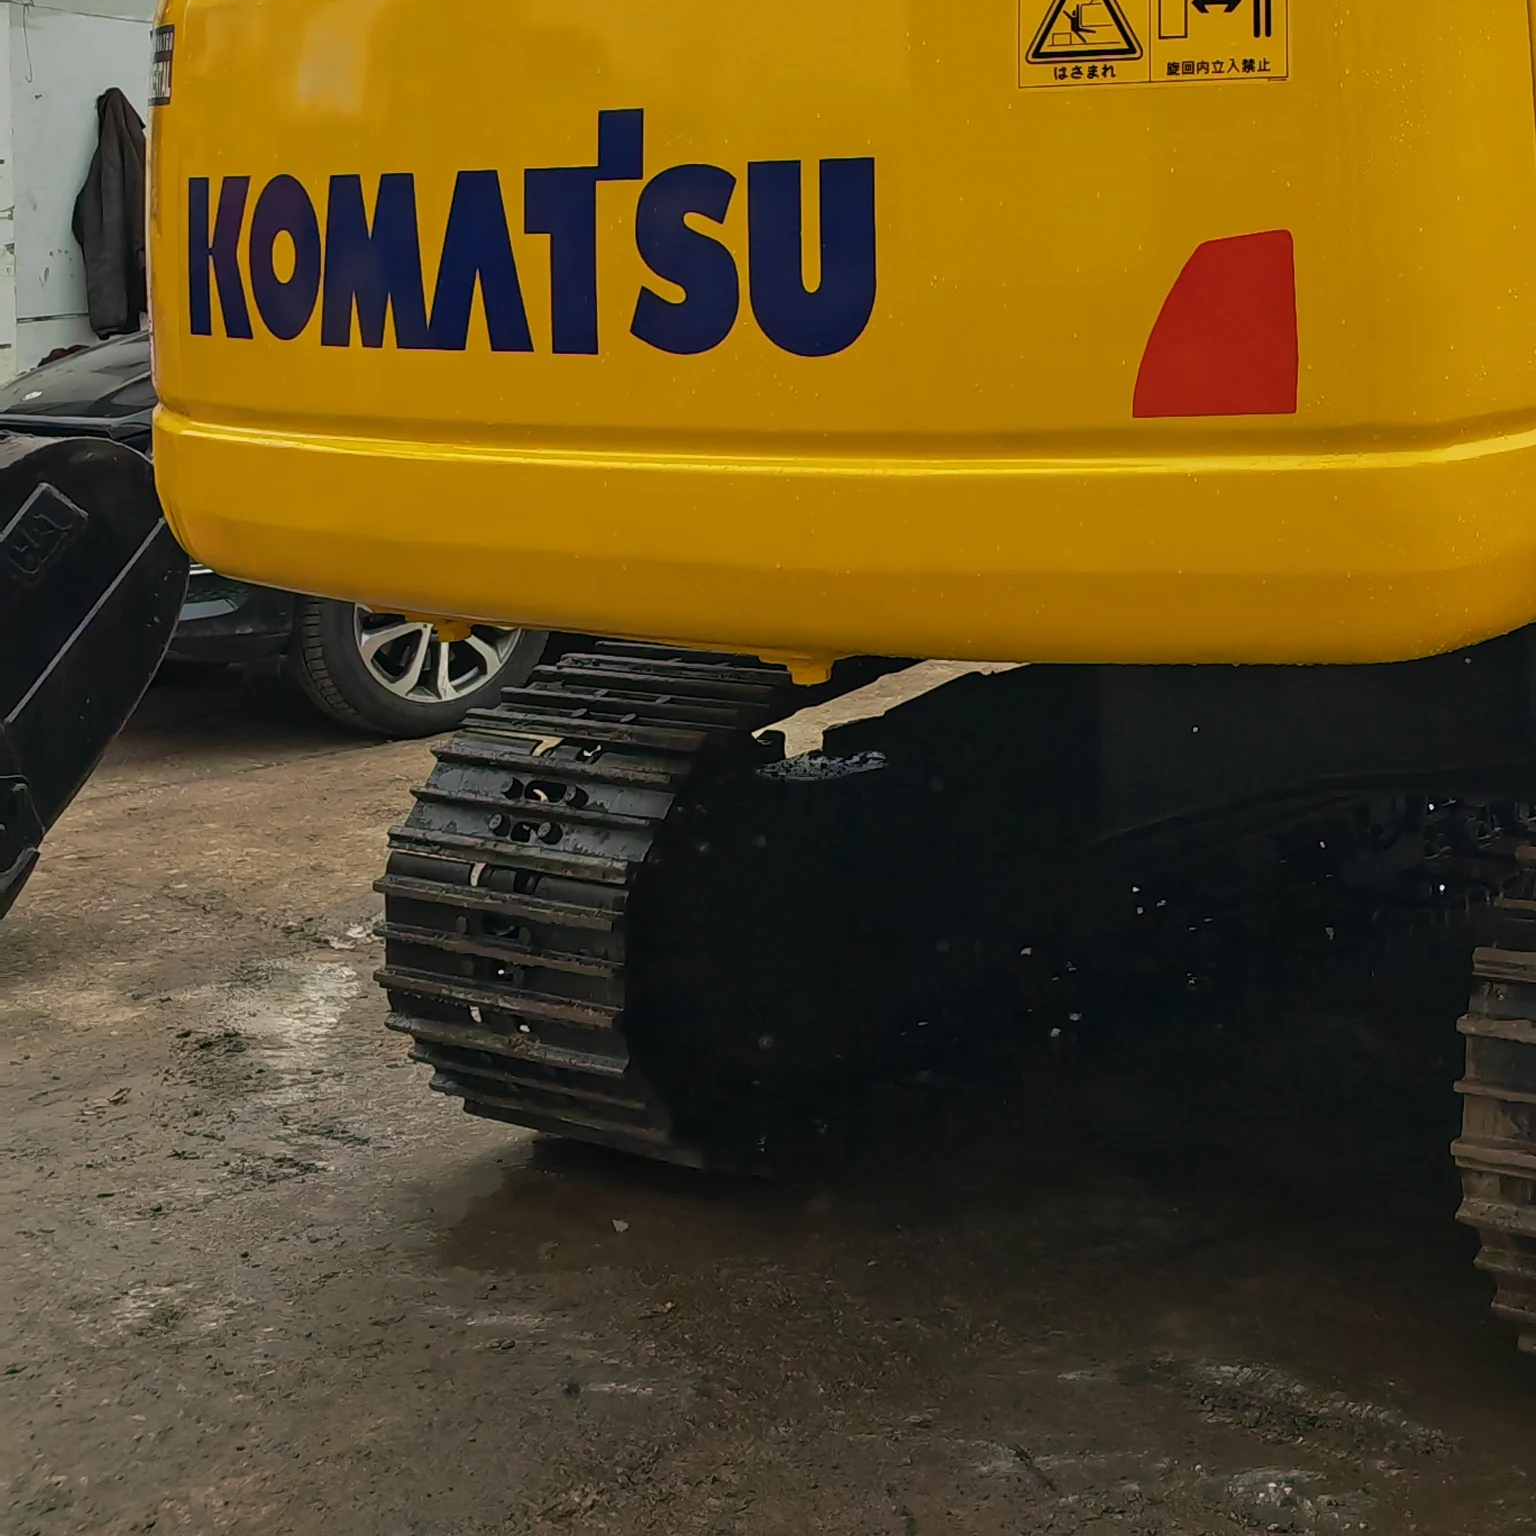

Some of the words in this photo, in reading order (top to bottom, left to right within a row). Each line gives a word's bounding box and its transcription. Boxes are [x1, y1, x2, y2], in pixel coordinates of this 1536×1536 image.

[1053, 64, 1117, 81] はさまれ
[1166, 57, 1272, 76] 旋回内立入禁止
[188, 108, 877, 357] KOMATSU
